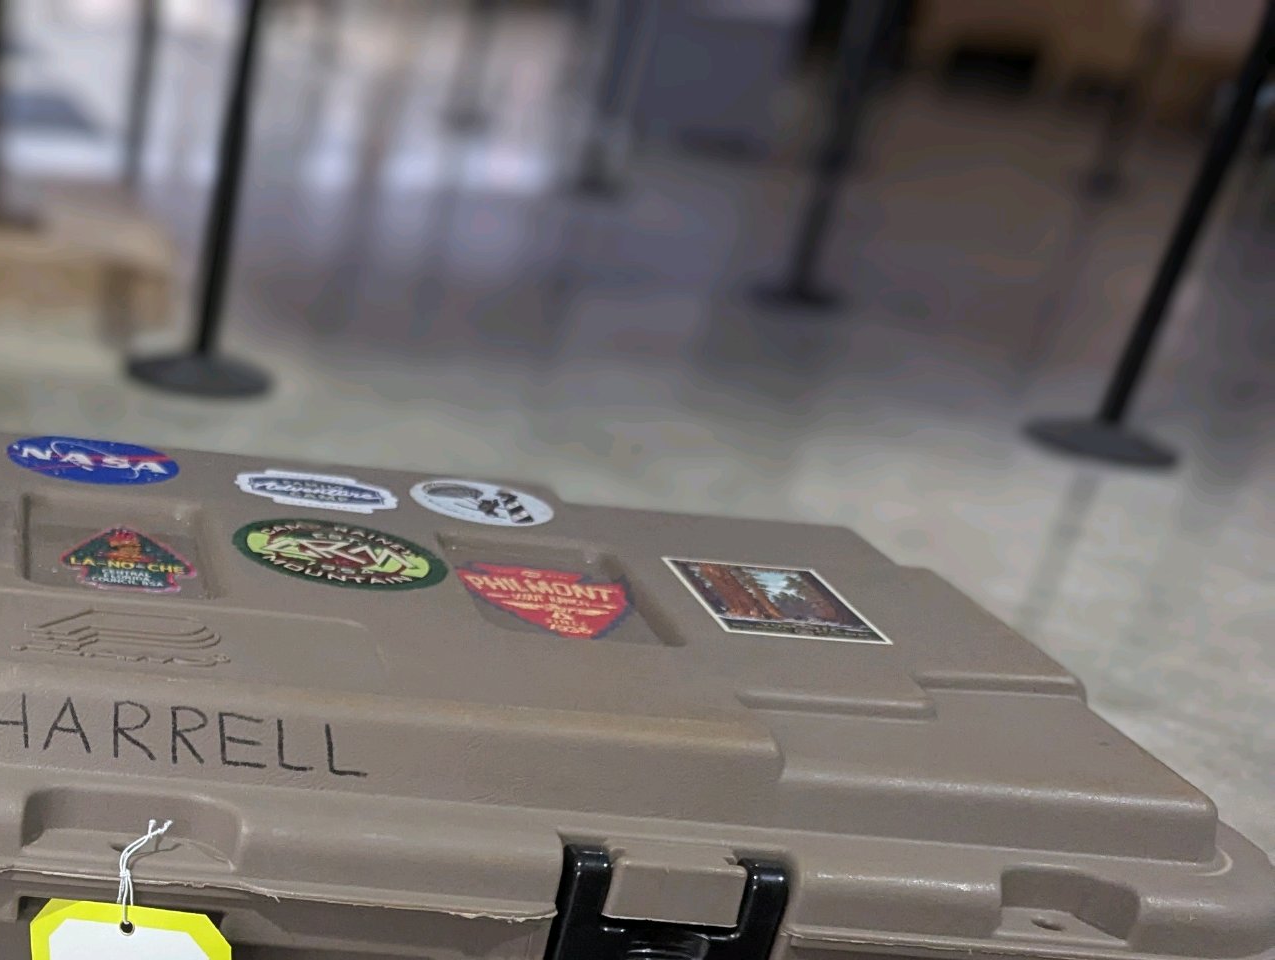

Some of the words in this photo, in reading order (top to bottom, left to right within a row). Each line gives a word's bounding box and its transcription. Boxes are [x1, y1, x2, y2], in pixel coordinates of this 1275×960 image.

[21, 447, 169, 474] NASA
[69, 557, 184, 575] LA-NO-CHE
[262, 555, 413, 585] MOUNTAIN
[465, 574, 615, 602] PHILMONT
